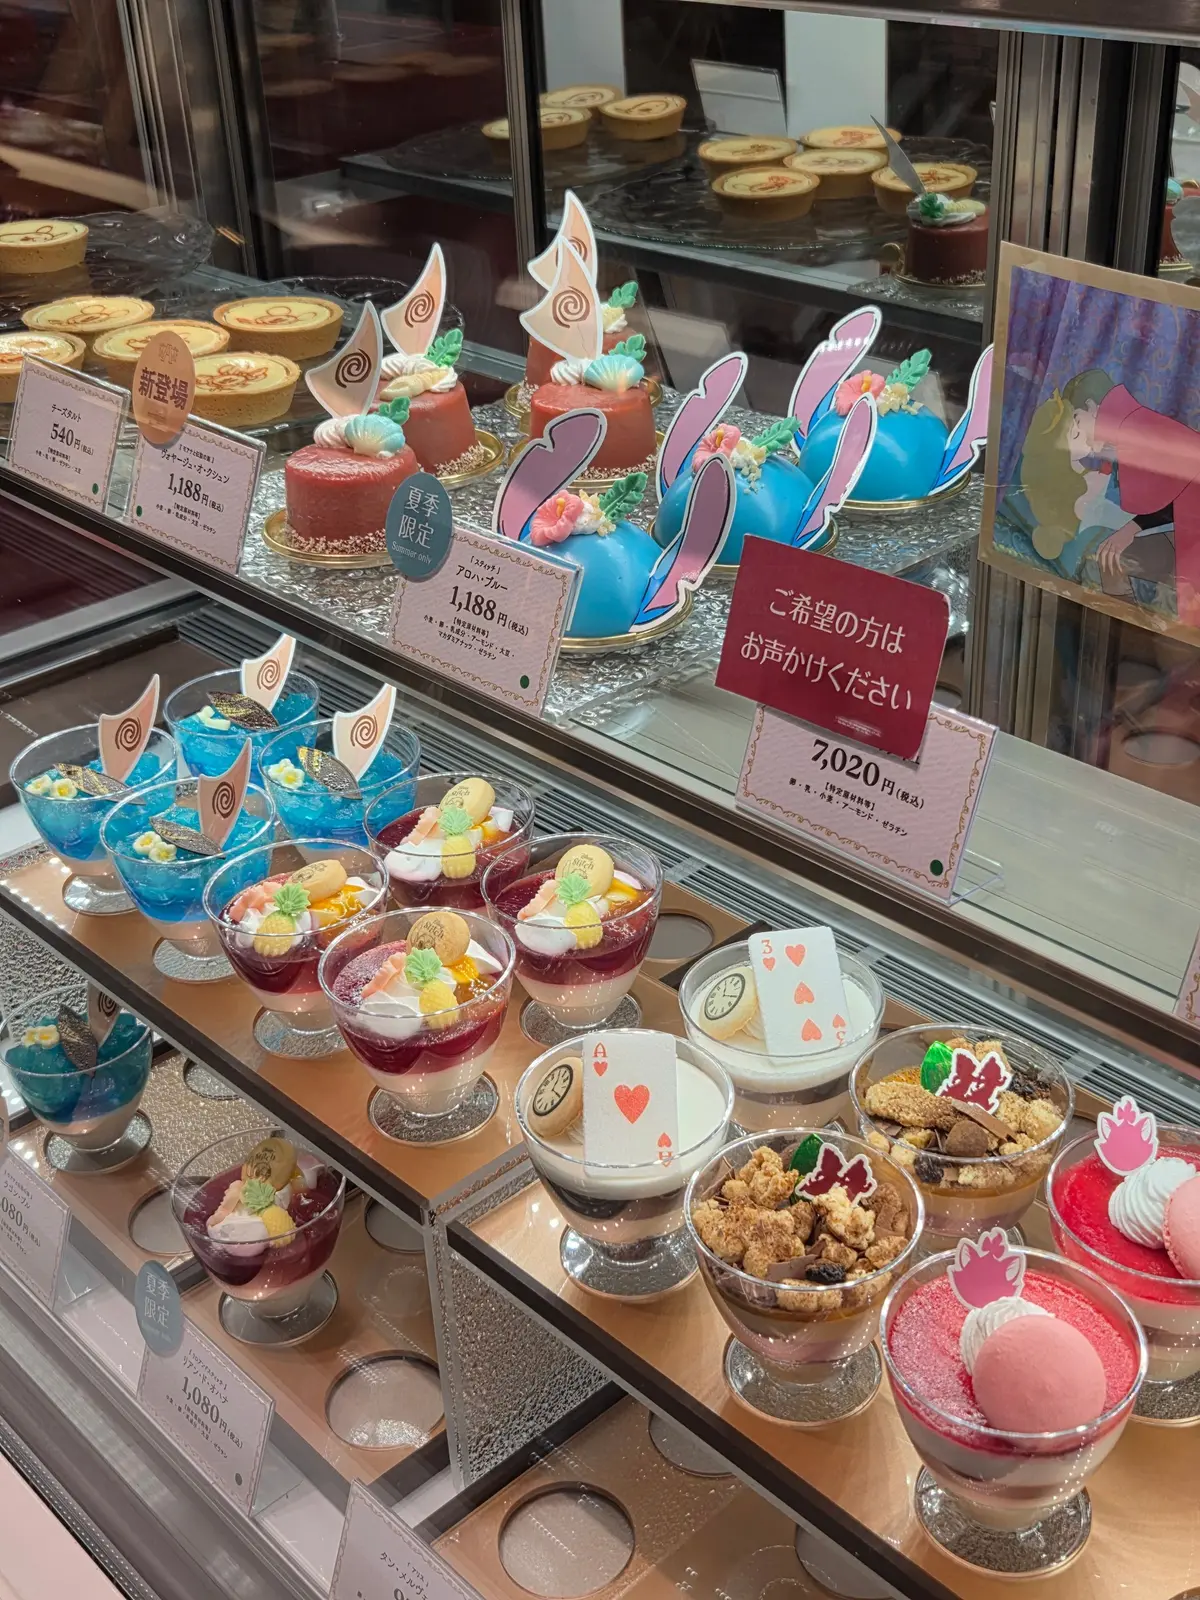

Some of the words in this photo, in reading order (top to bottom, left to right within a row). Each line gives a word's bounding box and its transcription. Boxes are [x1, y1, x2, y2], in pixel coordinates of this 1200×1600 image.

[138, 366, 189, 411] 新登場
[51, 403, 82, 423] チーズタルト
[404, 485, 440, 517] 夏季
[398, 514, 435, 549] 限定
[456, 564, 508, 591] アロハ・ブルー
[769, 587, 906, 654] ご希望の方は
[740, 631, 912, 711] お声かけください
[760, 939, 774, 955] 3
[592, 1041, 608, 1058] A
[145, 1271, 171, 1301] 夏季
[143, 1296, 170, 1329] 限定
[182, 1355, 229, 1404] リアン・ド・オハナ
